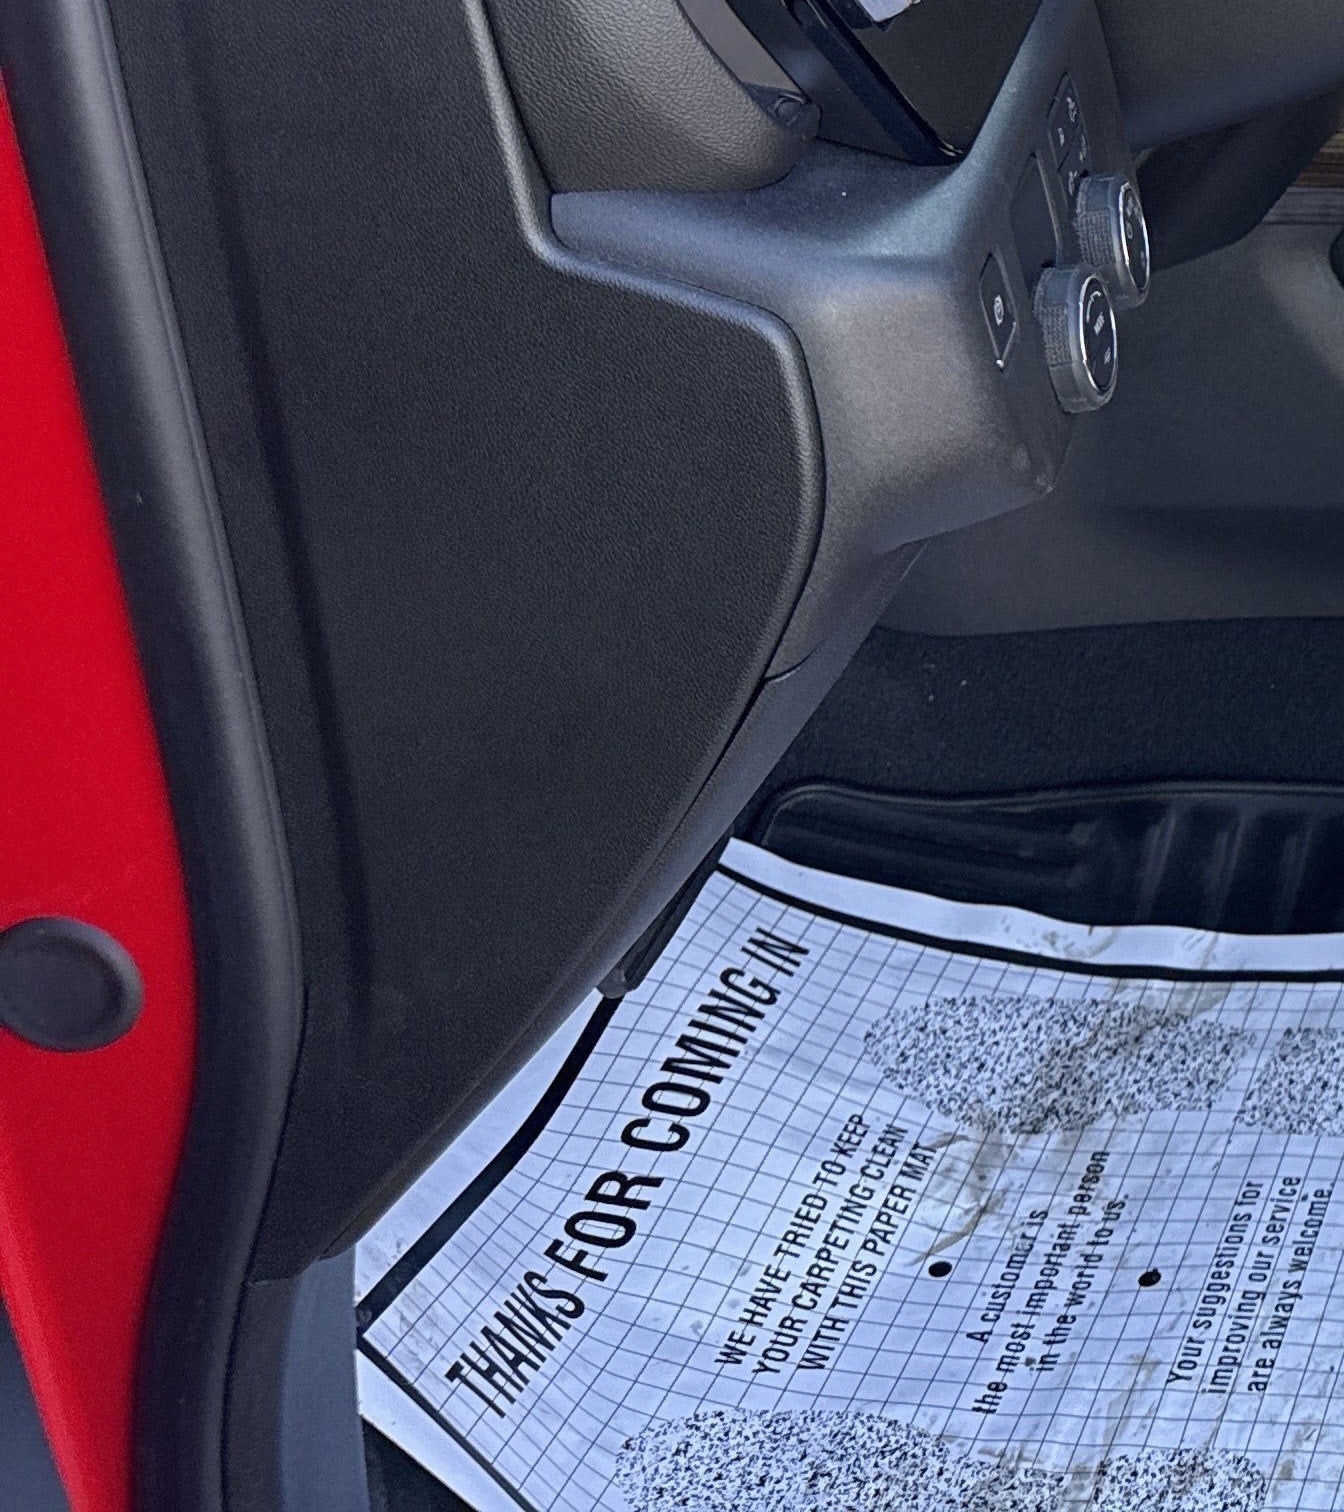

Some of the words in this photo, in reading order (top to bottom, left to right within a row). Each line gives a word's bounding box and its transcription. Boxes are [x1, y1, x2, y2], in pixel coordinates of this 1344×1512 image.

[829, 1113, 871, 1158] KEEP
[444, 1270, 585, 1418] THANKS
[543, 1170, 665, 1282] FOR
[620, 966, 782, 1152] COMING
[741, 927, 810, 977] IN
[812, 1159, 847, 1187] TO
[1068, 1150, 1111, 1216] person
[773, 1193, 828, 1258] TRIED
[1086, 1226, 1114, 1248] to
[1102, 1193, 1130, 1222] us.
[752, 1315, 808, 1374] YOUR
[791, 1183, 876, 1311] CARPETING
[860, 1123, 909, 1181] CLEAN
[799, 1315, 850, 1370] WITH
[831, 1259, 878, 1309] THIS
[861, 1185, 918, 1256] PAPER
[898, 1141, 938, 1181] MAT
[966, 1329, 993, 1344] A
[980, 1230, 1038, 1324] customer
[1020, 1208, 1050, 1228] is
[1015, 1221, 1081, 1317] important
[738, 1264, 792, 1327] HAVE
[1064, 1253, 1104, 1308] world
[1166, 1336, 1205, 1384] Your
[1193, 1212, 1252, 1331] suggestions
[1233, 1181, 1263, 1207] for
[1201, 1288, 1266, 1394] improving
[1248, 1250, 1275, 1283] our
[1262, 1175, 1301, 1245] service
[1247, 1357, 1275, 1393] are
[1262, 1279, 1303, 1350] always
[1287, 1181, 1336, 1274] welcome.
[715, 1330, 757, 1365] WE
[996, 1322, 1036, 1373] most
[1029, 1351, 1061, 1372] in
[1042, 1314, 1077, 1346] the
[971, 1380, 1008, 1415] the
